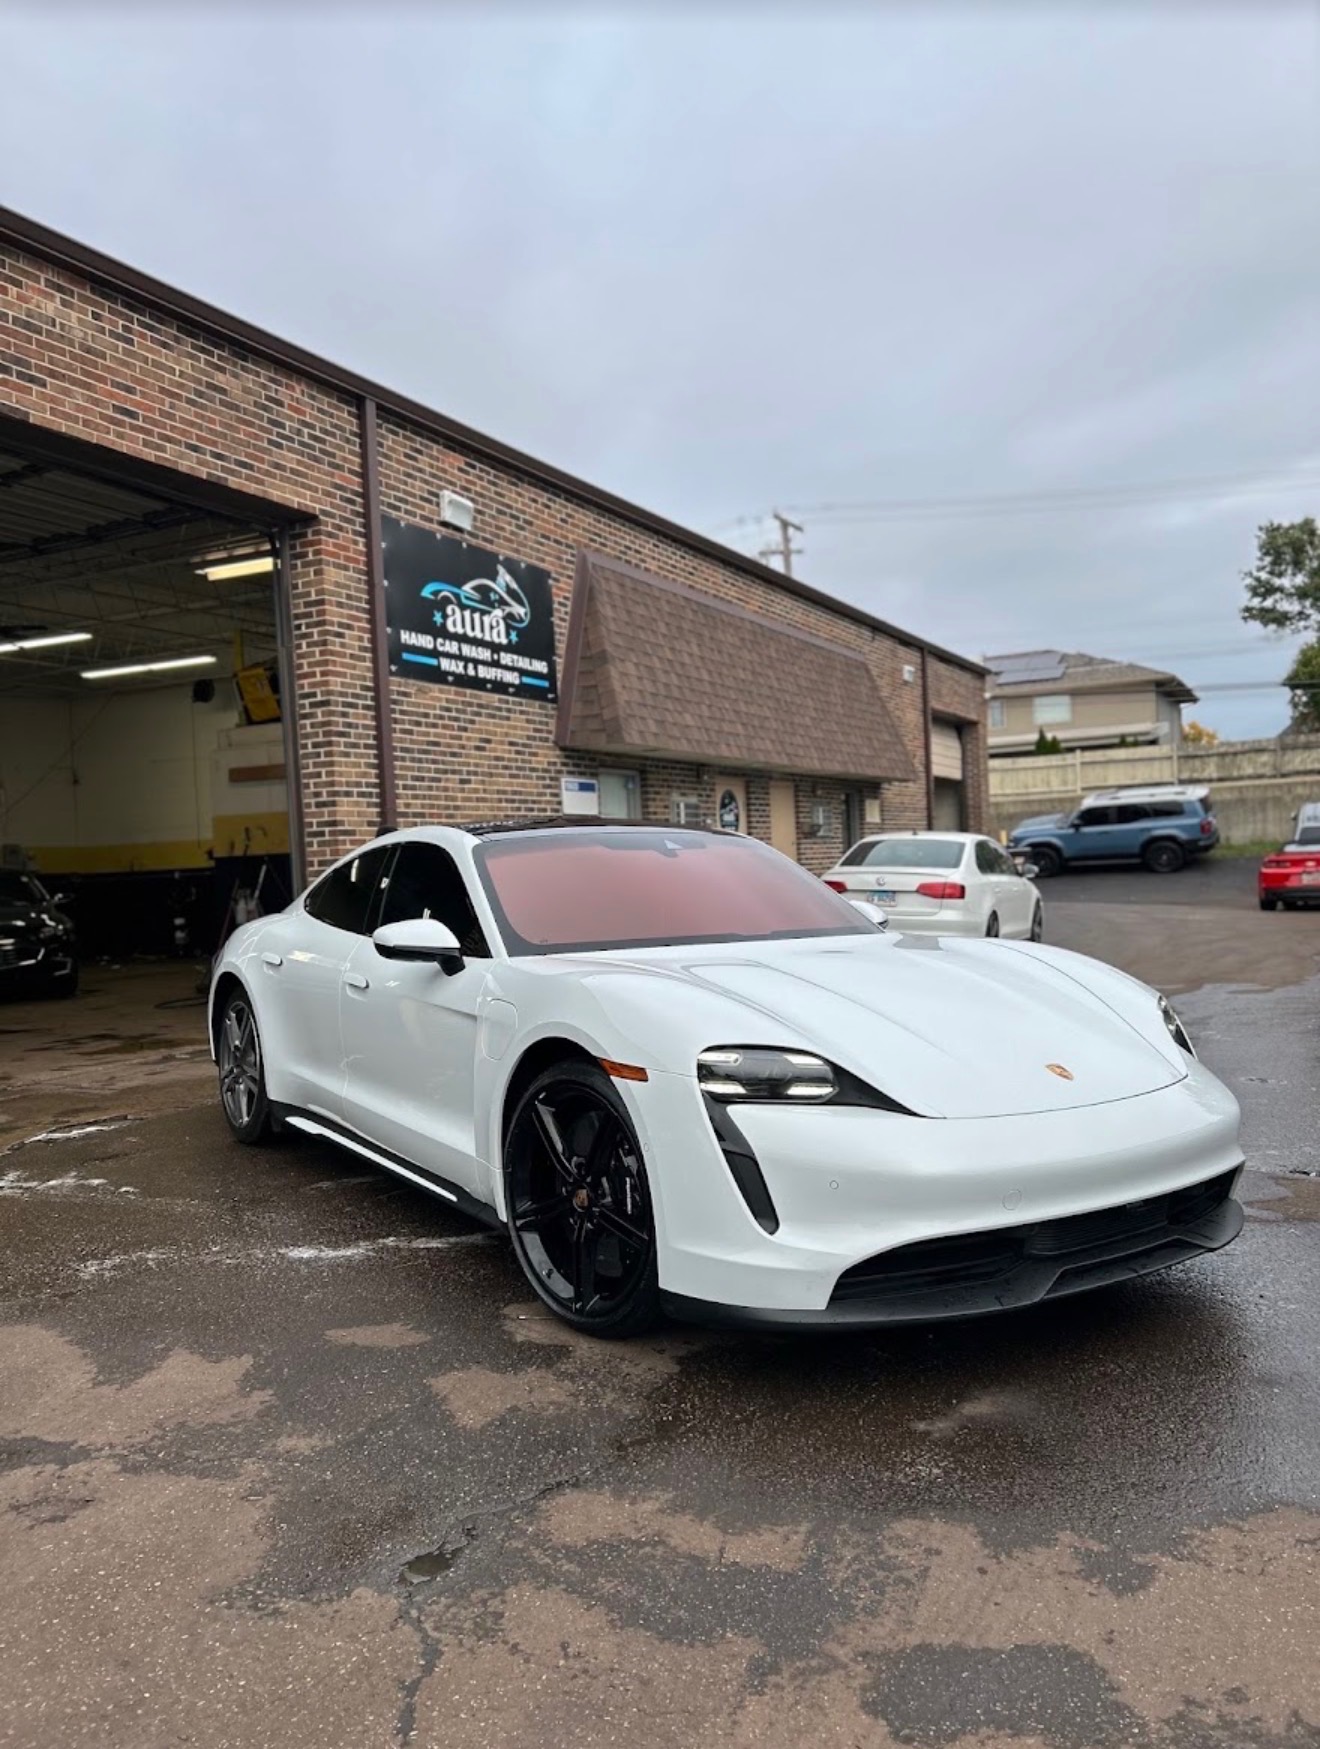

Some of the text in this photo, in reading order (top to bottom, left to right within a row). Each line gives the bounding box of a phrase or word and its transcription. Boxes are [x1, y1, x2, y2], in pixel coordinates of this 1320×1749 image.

[445, 604, 508, 645] aura
[400, 629, 549, 674] HAND CAR WASH DETAILING
[439, 656, 520, 685] WAX & BUFFING
